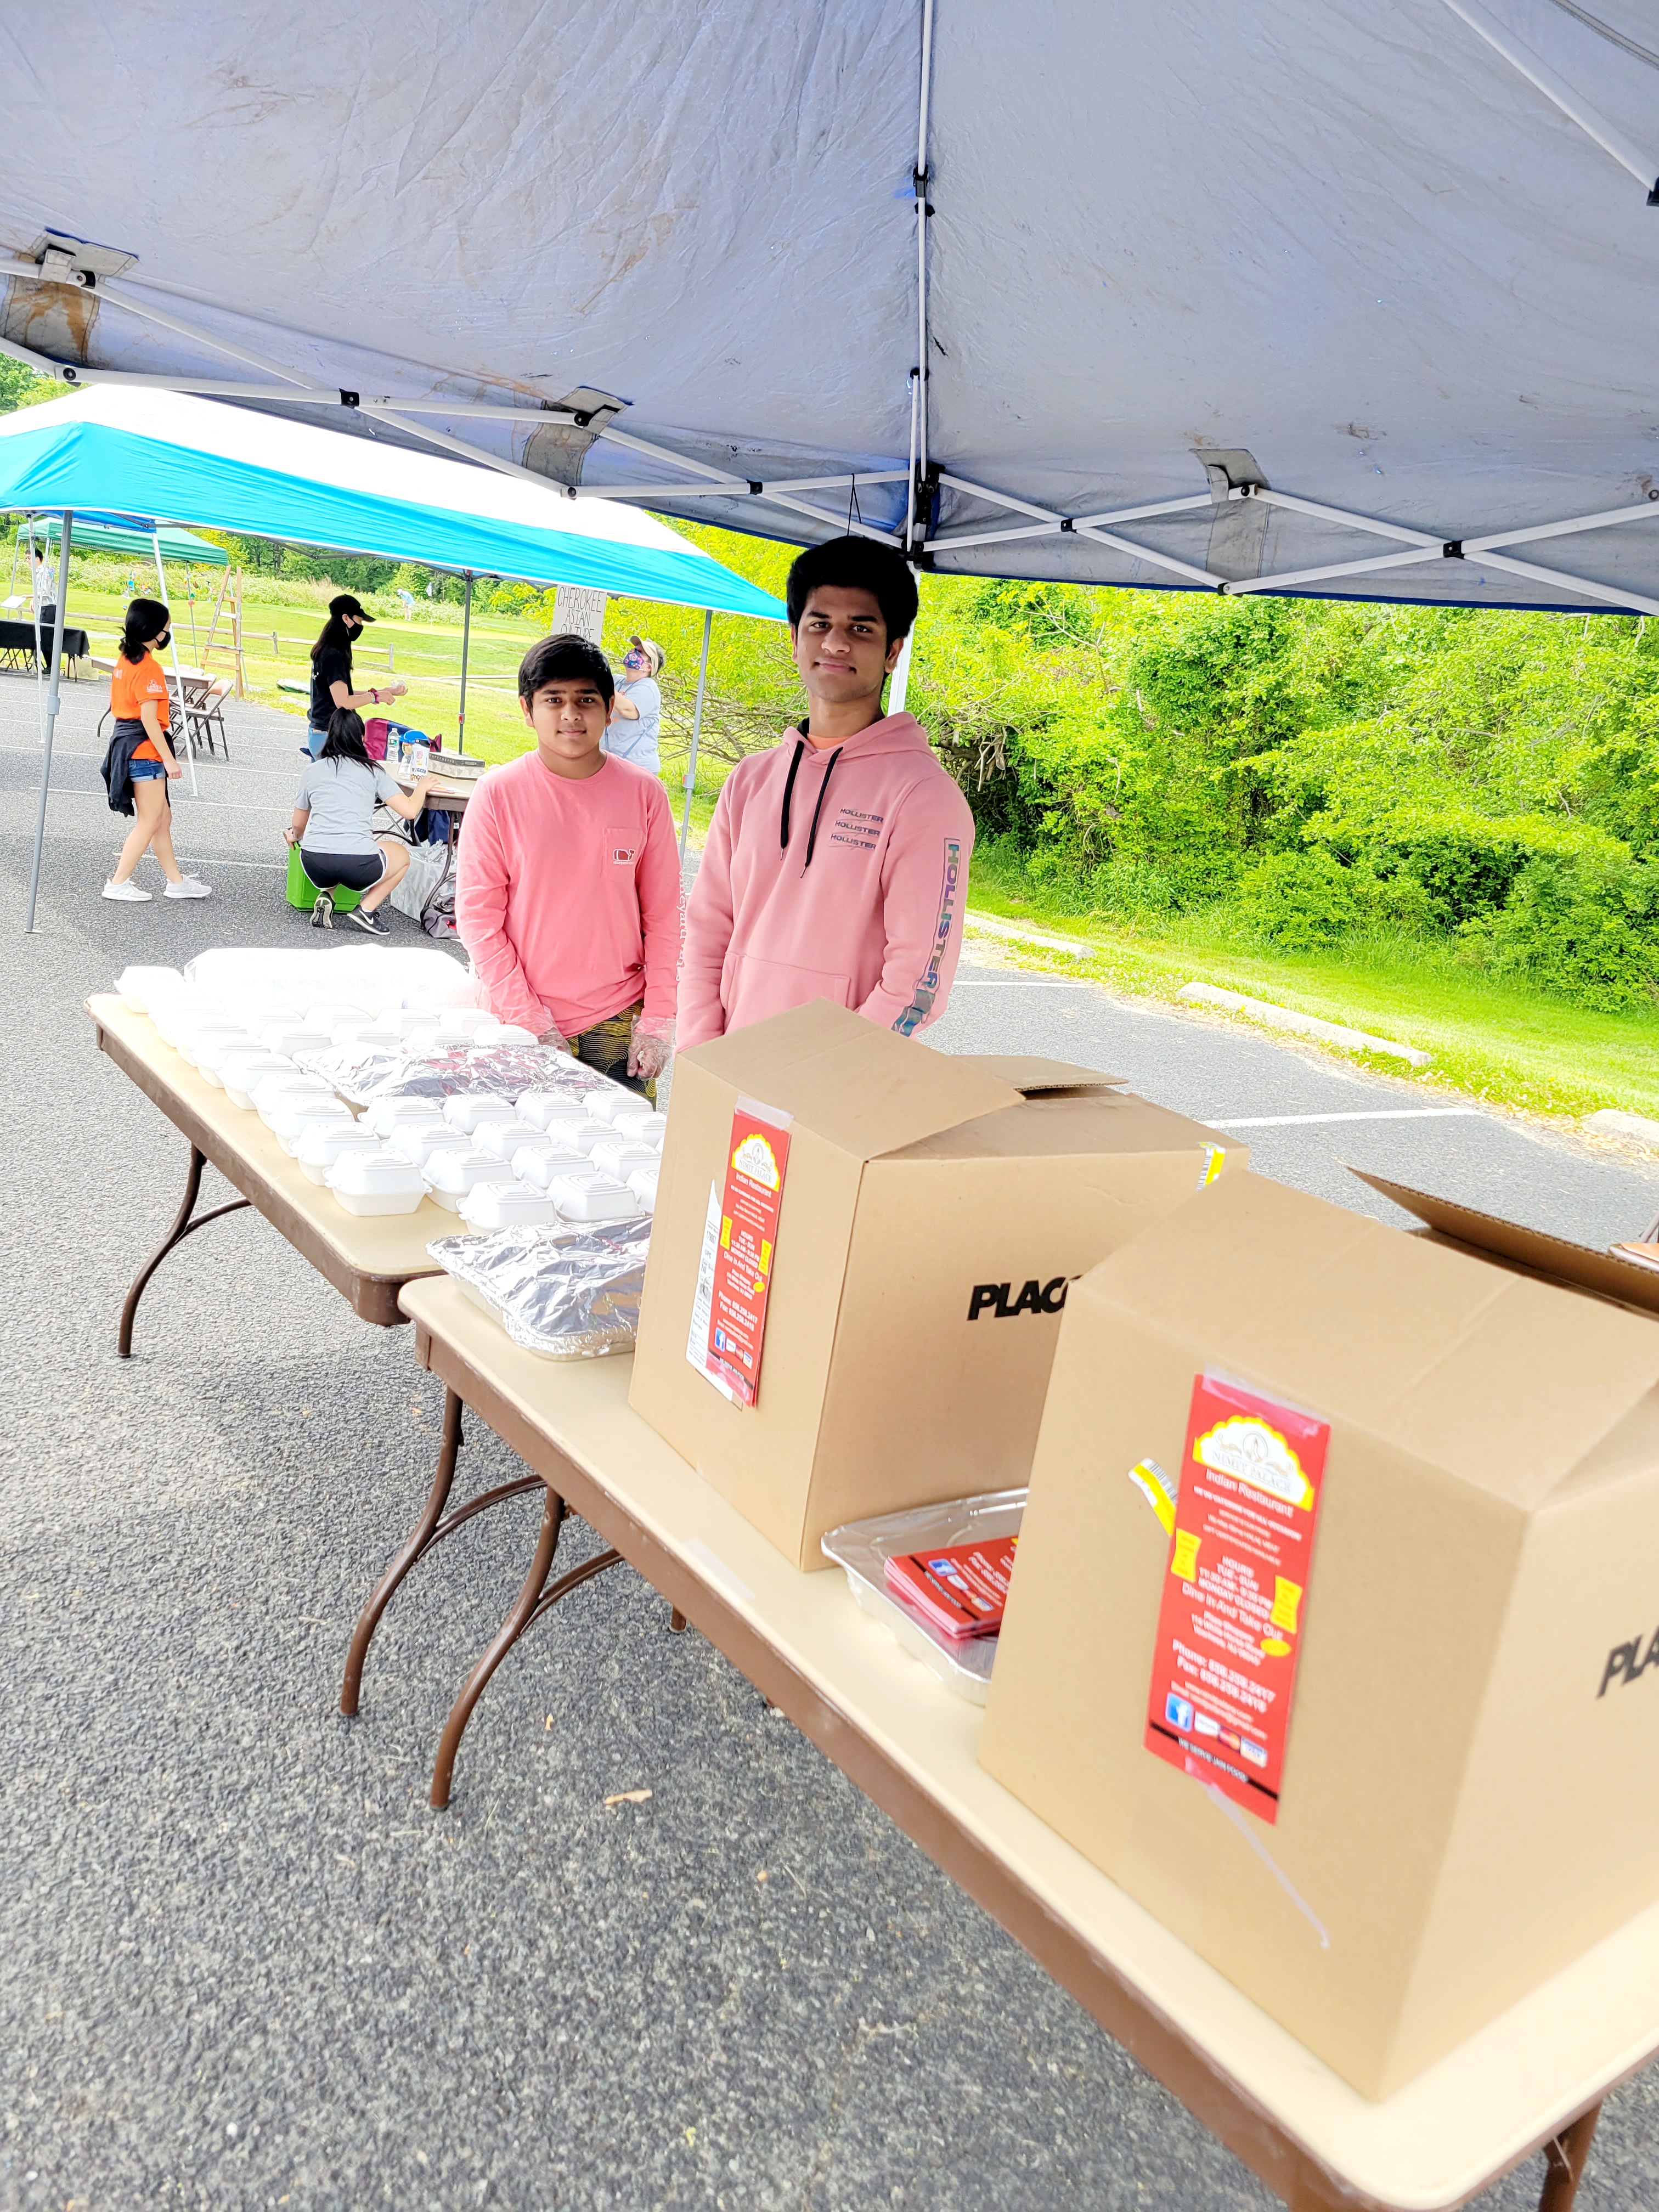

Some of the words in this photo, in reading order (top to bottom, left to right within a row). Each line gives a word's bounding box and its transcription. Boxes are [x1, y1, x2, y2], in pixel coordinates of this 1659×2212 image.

[557, 586, 605, 613] CHEROKEE
[565, 608, 591, 627] ASIAN
[835, 820, 880, 836] HOLLISTER
[840, 808, 884, 822] HOLLISTER
[831, 833, 876, 849] HOLLISTER
[923, 844, 959, 989] HOLLISTER
[739, 1160, 753, 1172] NIMIT
[754, 1167, 771, 1182] PALACE
[735, 1172, 748, 1185] Indian
[748, 1178, 772, 1198] Restaurant
[723, 1250, 733, 1263] Dine
[737, 1260, 745, 1271] And
[745, 1265, 754, 1277] Take
[966, 1274, 1083, 1321] PLAC
[1205, 1468, 1237, 1492] Indian
[1237, 1483, 1294, 1519] Restaurant
[1216, 1562, 1234, 1579] TUE
[1238, 1573, 1259, 1592] SUN
[1221, 1555, 1254, 1579] HOURS
[1181, 1581, 1205, 1603] Dine
[1205, 1593, 1216, 1609] In
[1215, 1598, 1238, 1620] And
[1238, 1610, 1261, 1632] Take
[1262, 1622, 1283, 1643] Out
[1198, 1576, 1234, 1602] MONDAY
[1234, 1595, 1269, 1621] CLOSED
